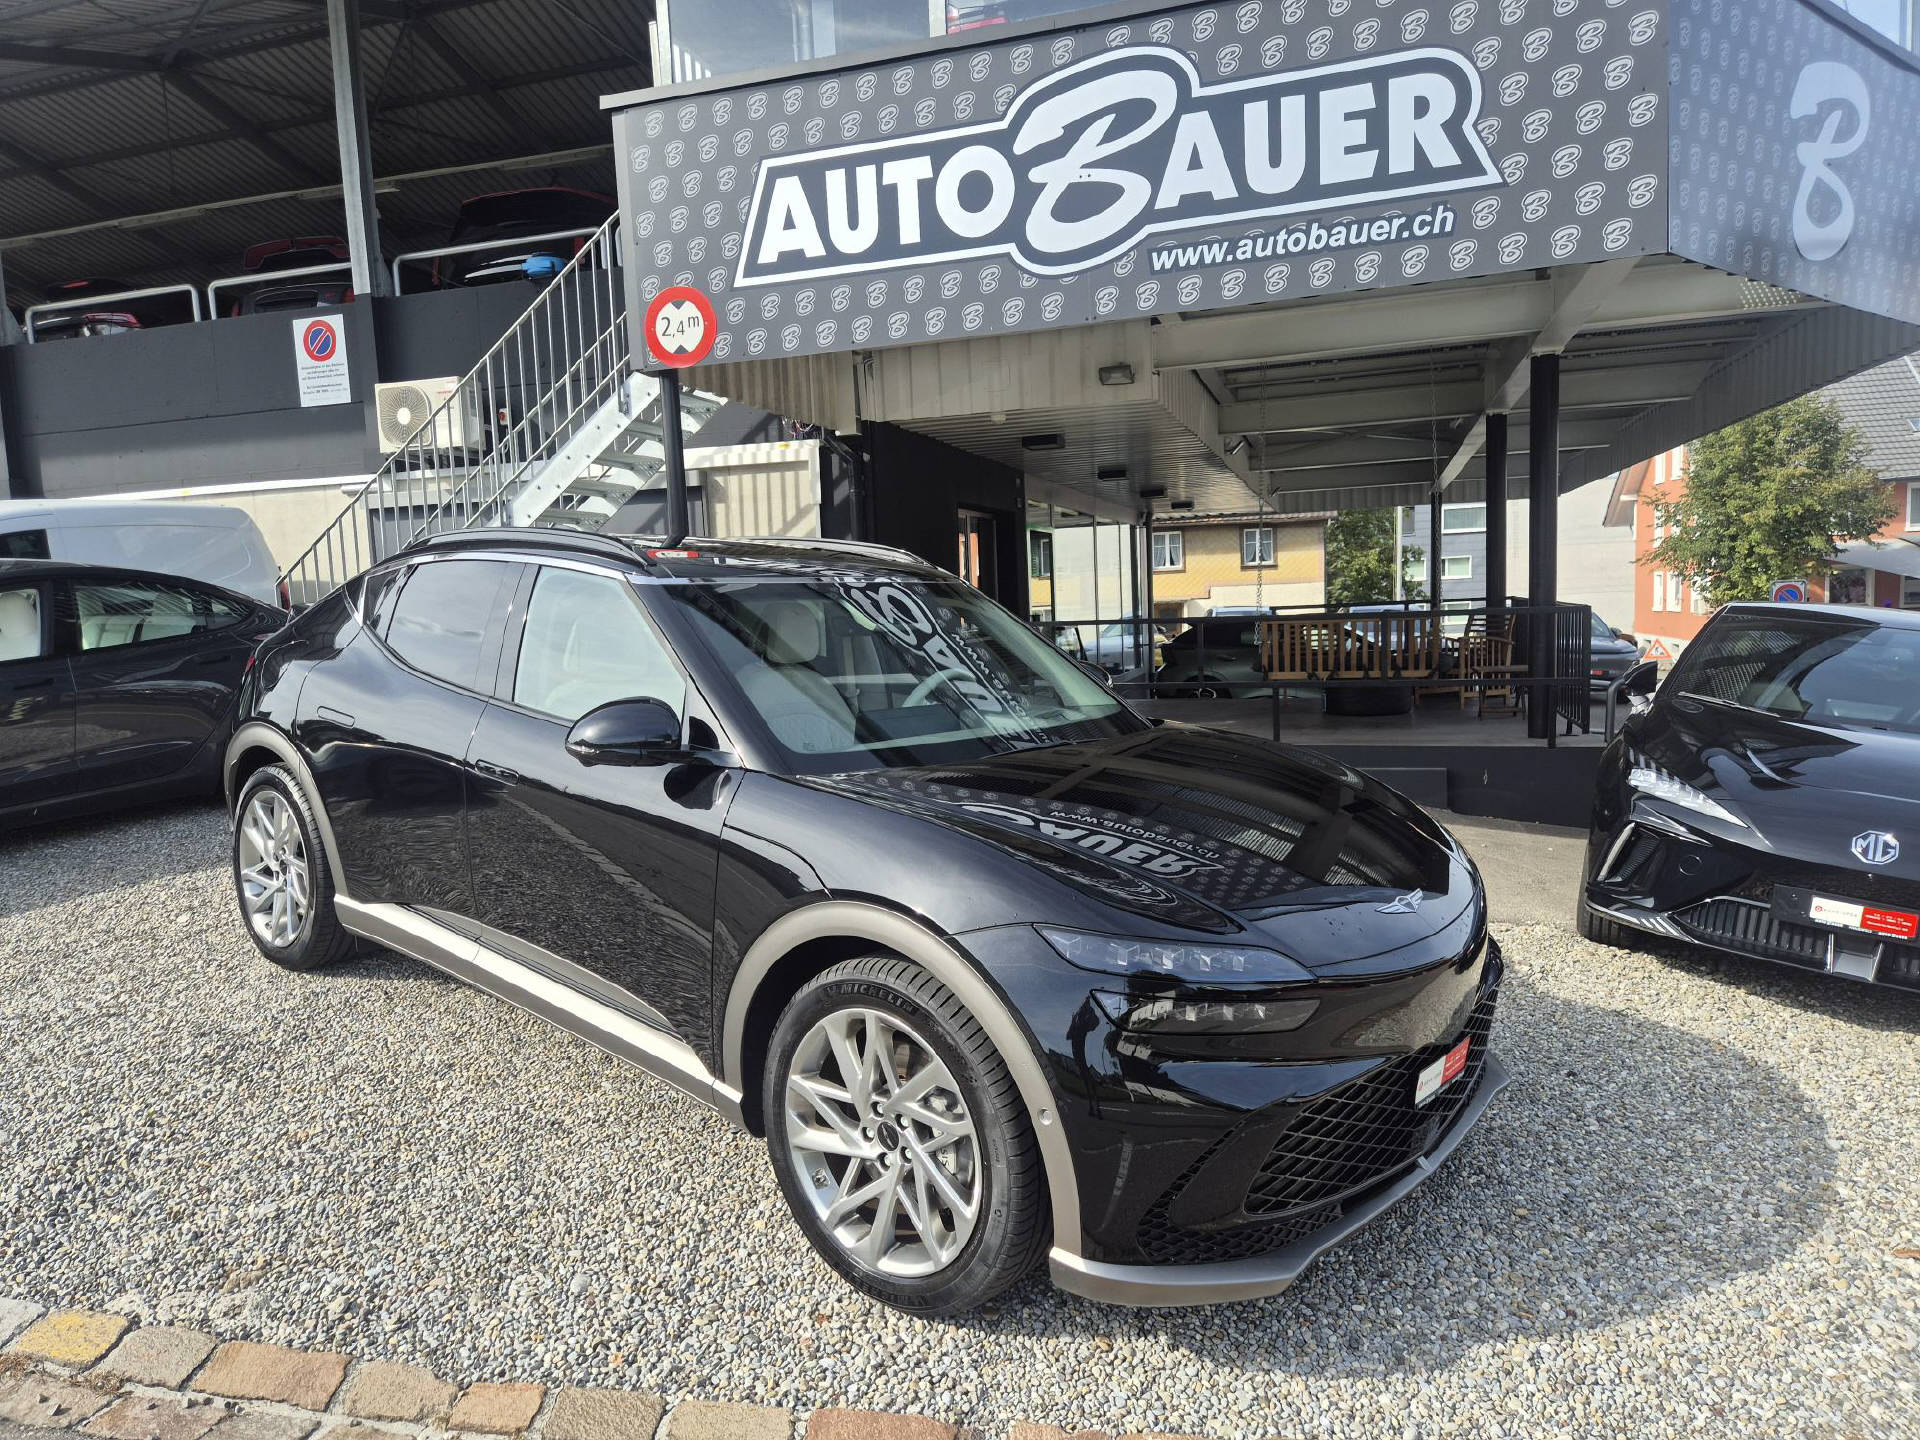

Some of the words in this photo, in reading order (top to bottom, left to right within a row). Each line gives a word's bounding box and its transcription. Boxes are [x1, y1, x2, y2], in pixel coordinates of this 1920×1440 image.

[757, 145, 1015, 264] AUTO
[1013, 70, 1466, 252] BAUER
[1151, 205, 1456, 272] www.autobauer.ch
[1855, 833, 1897, 862] MG
[840, 983, 915, 1014] MICHELIN
